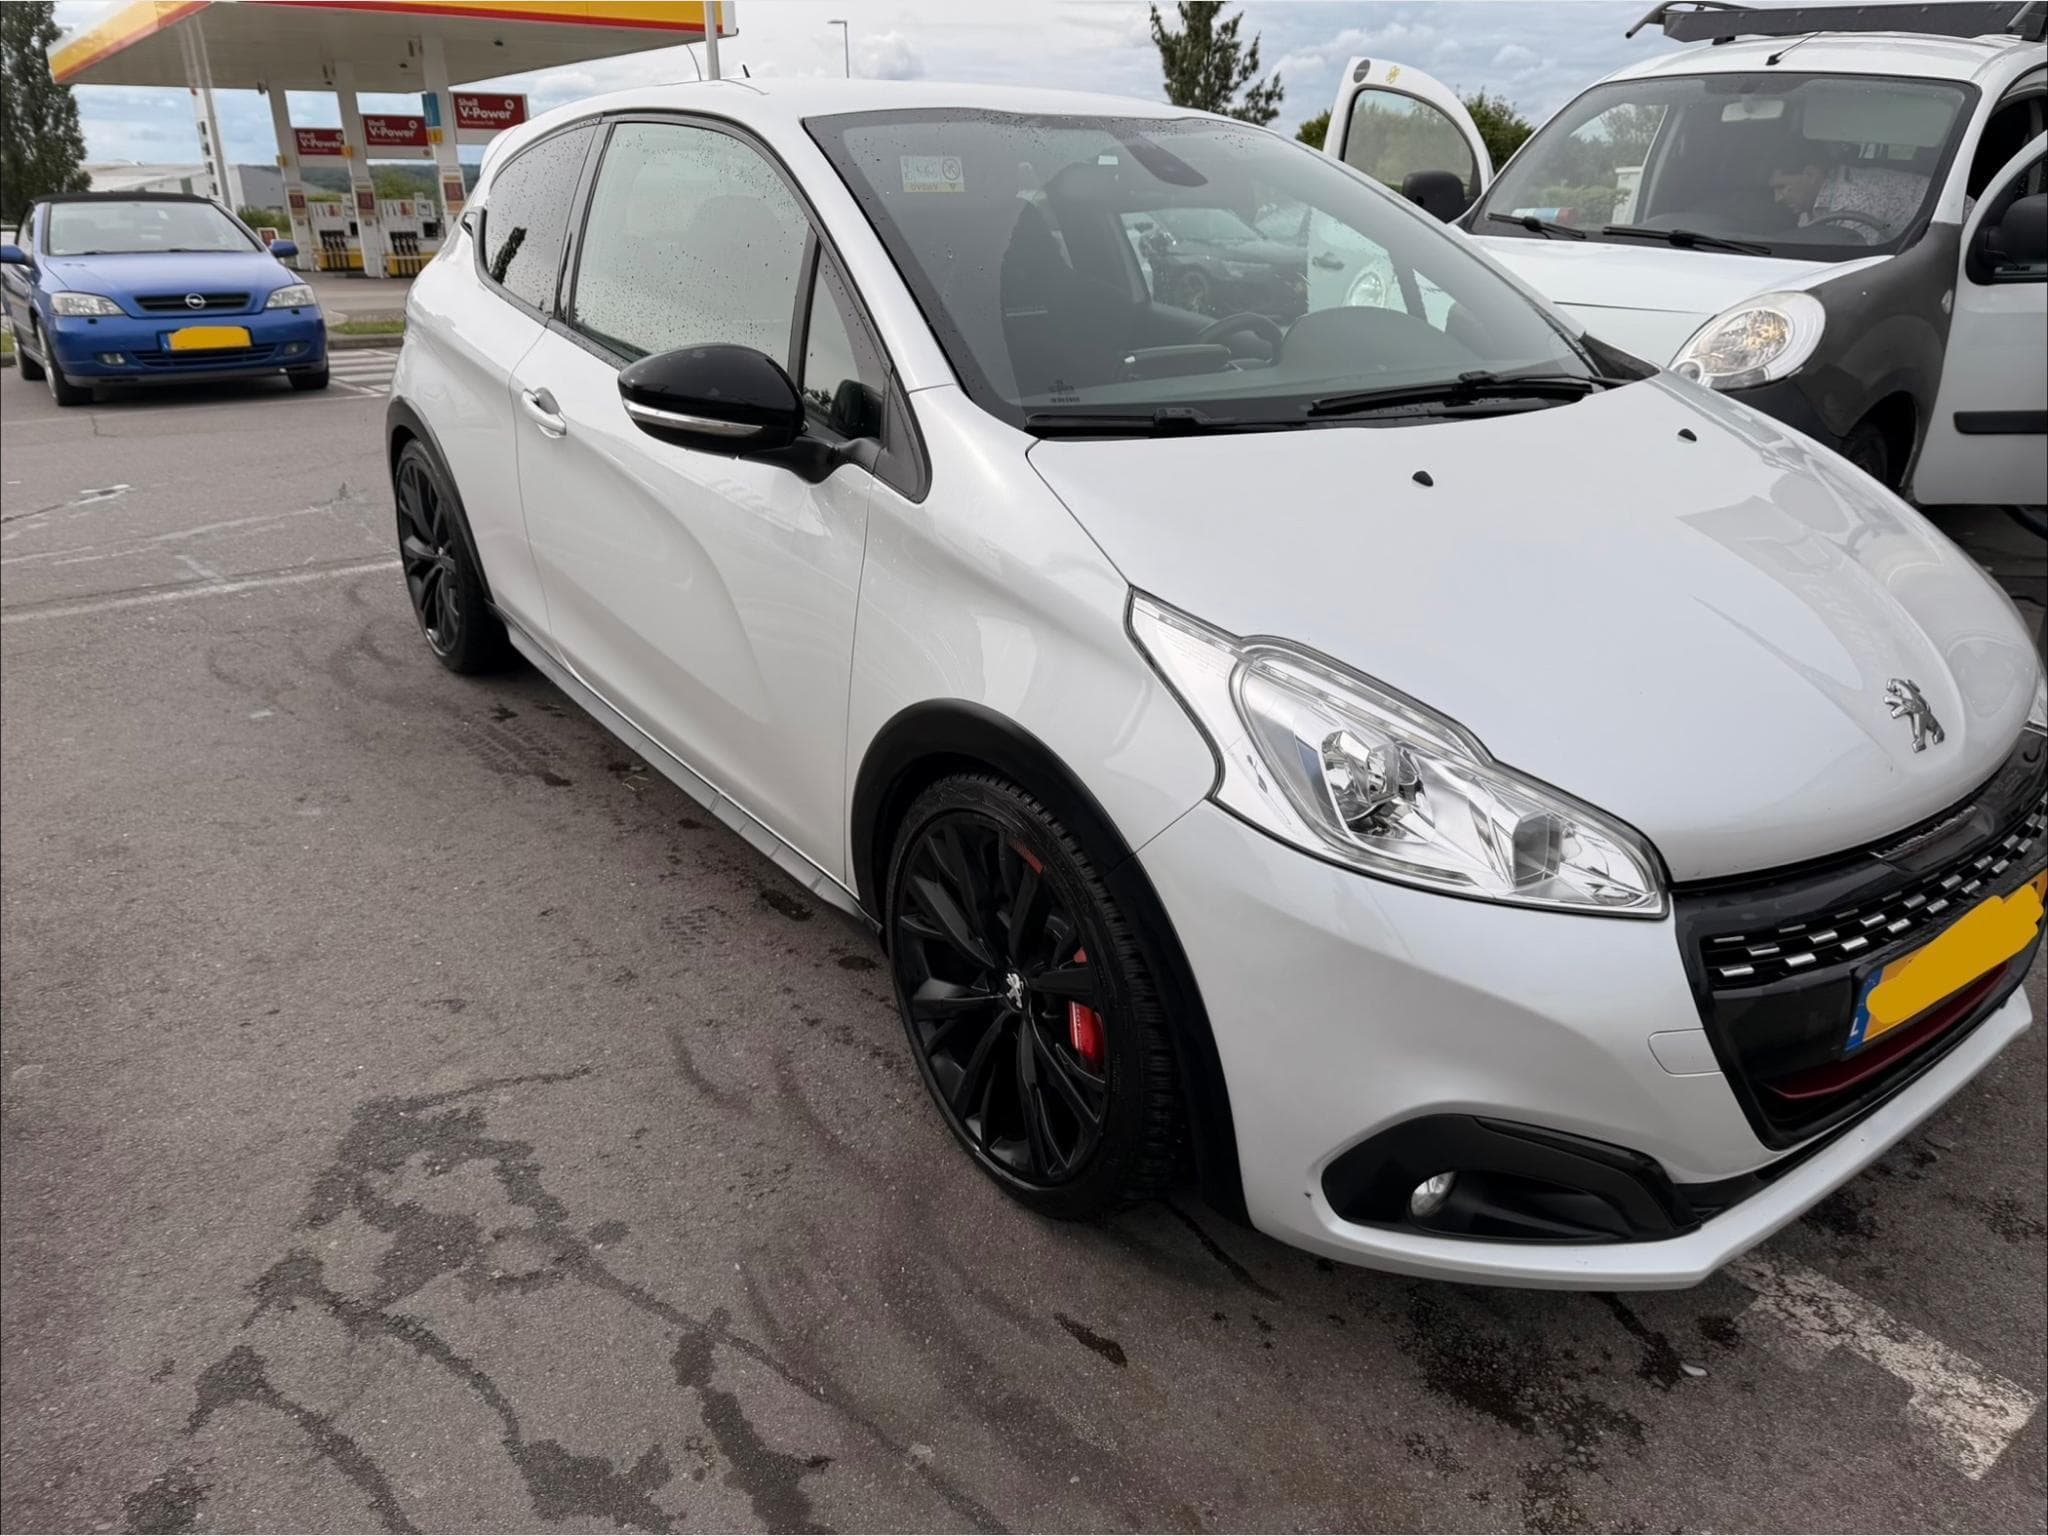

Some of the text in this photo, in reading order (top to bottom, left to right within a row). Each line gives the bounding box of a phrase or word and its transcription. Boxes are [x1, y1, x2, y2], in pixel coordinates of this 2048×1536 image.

[458, 98, 479, 106] Shell
[460, 106, 512, 119] V-Power
[370, 127, 415, 137] V-Power
[301, 139, 341, 148] V-Power
